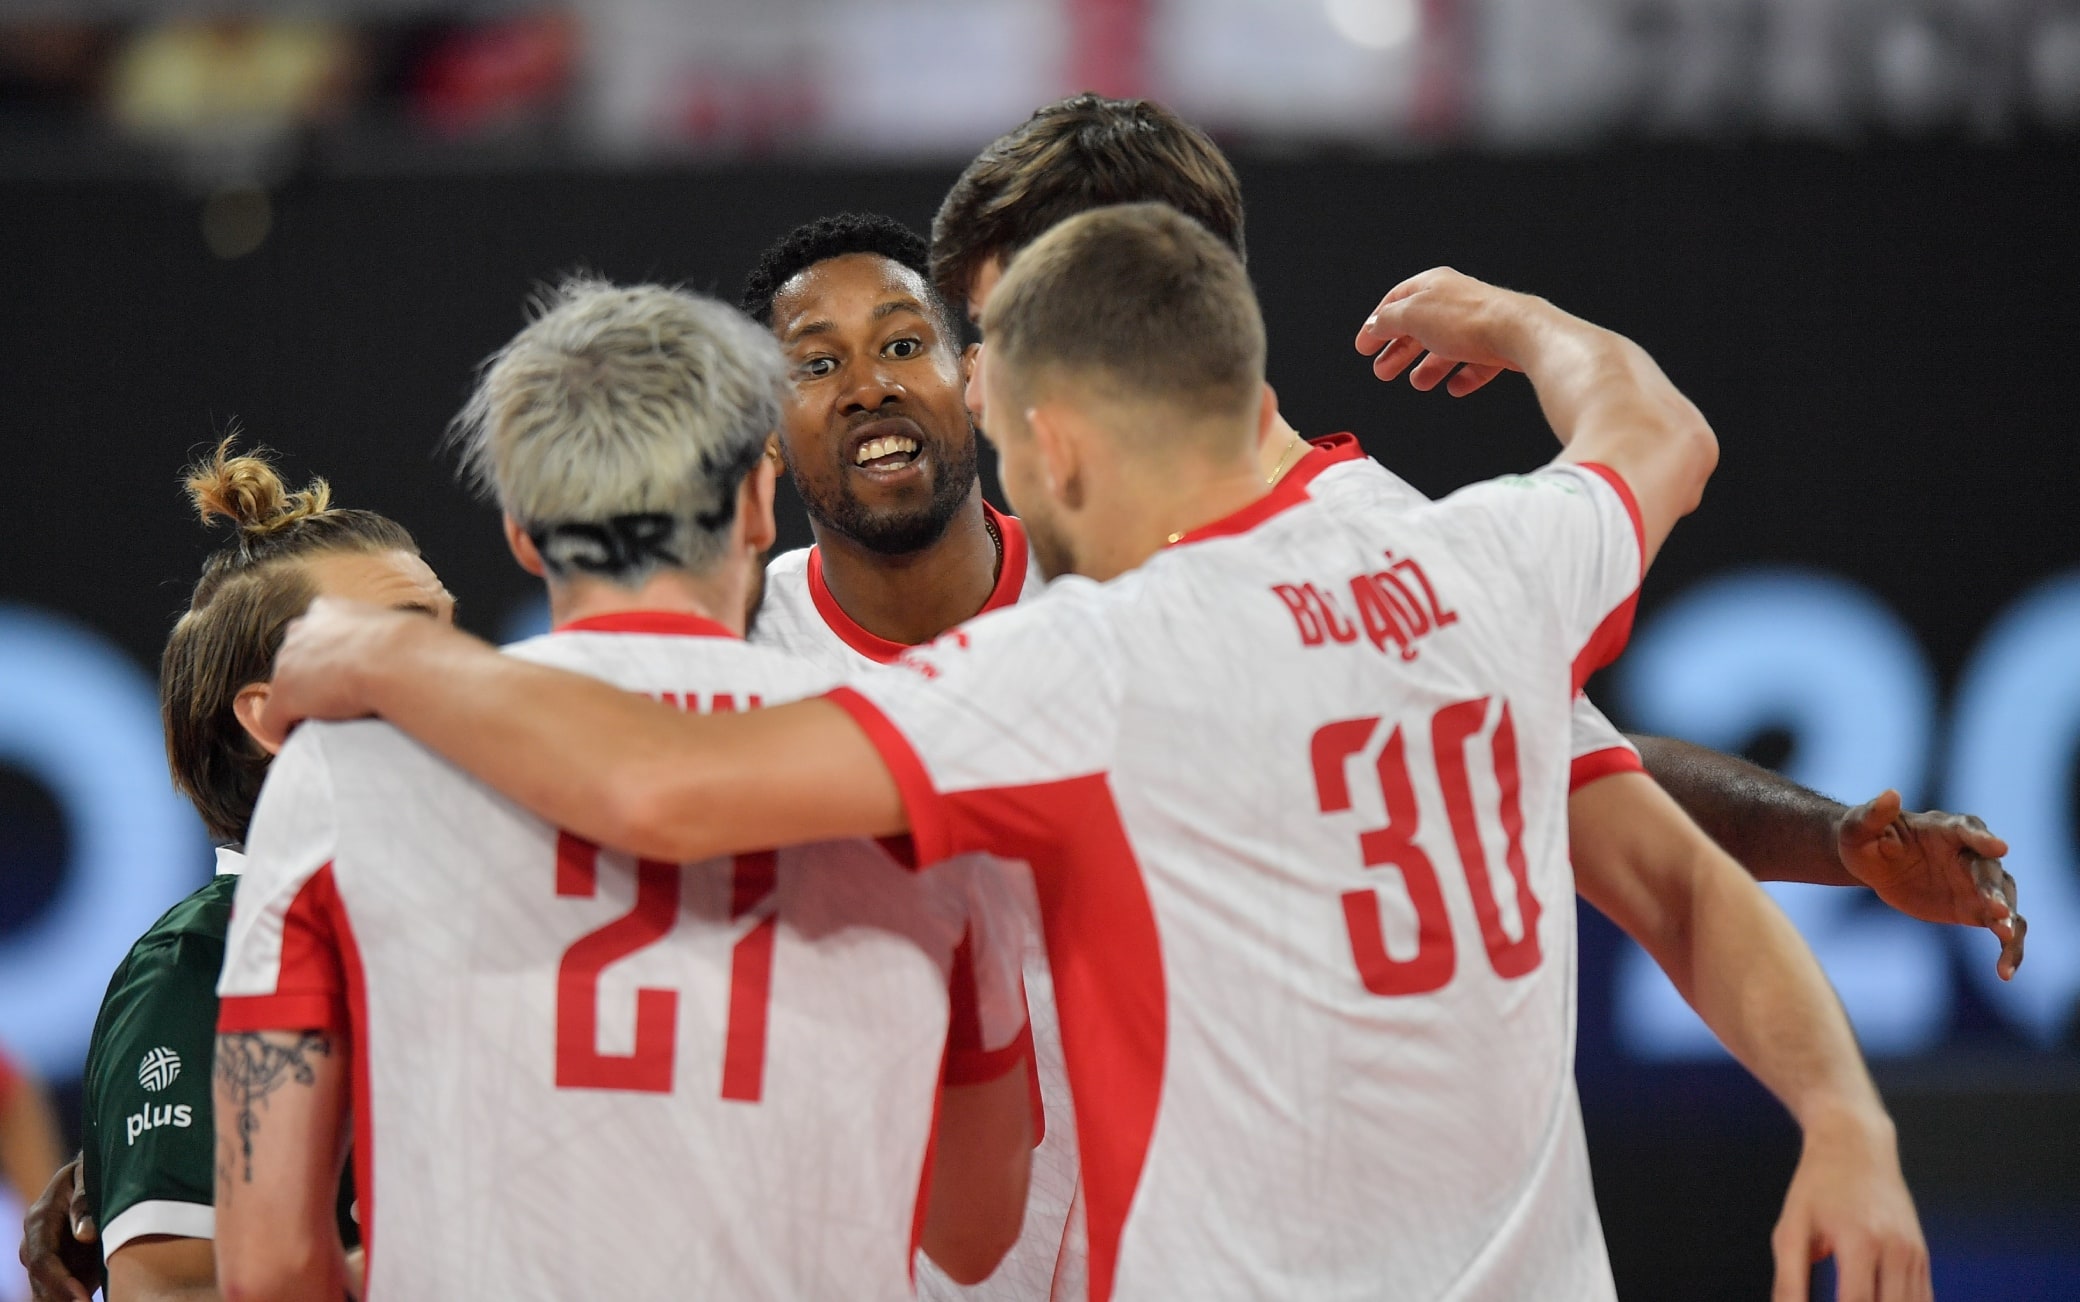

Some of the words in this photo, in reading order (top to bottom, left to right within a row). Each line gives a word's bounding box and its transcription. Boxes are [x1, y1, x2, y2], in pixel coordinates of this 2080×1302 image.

[555, 827, 779, 1105] 21
[1310, 695, 1544, 997] 30
[127, 1102, 193, 1147] plus
